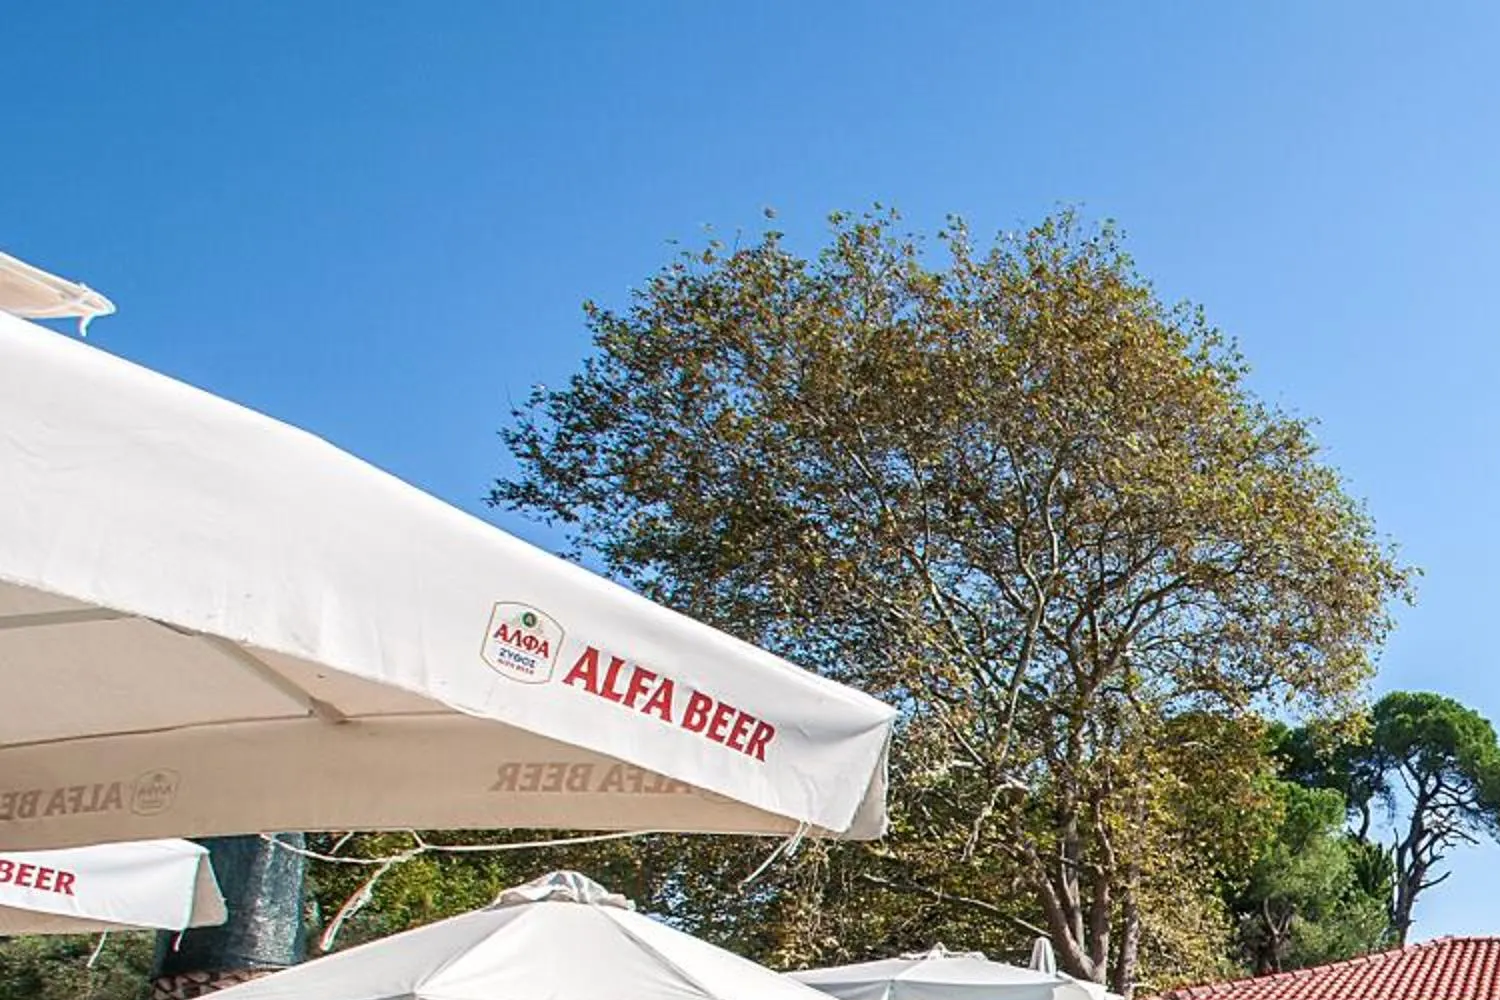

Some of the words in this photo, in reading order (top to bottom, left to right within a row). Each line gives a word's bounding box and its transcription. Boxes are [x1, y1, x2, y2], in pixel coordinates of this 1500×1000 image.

[493, 622, 549, 659] ΑΛΦΑ
[562, 645, 676, 724] ALFA
[680, 689, 776, 762] BEER
[0, 859, 77, 896] BEER
